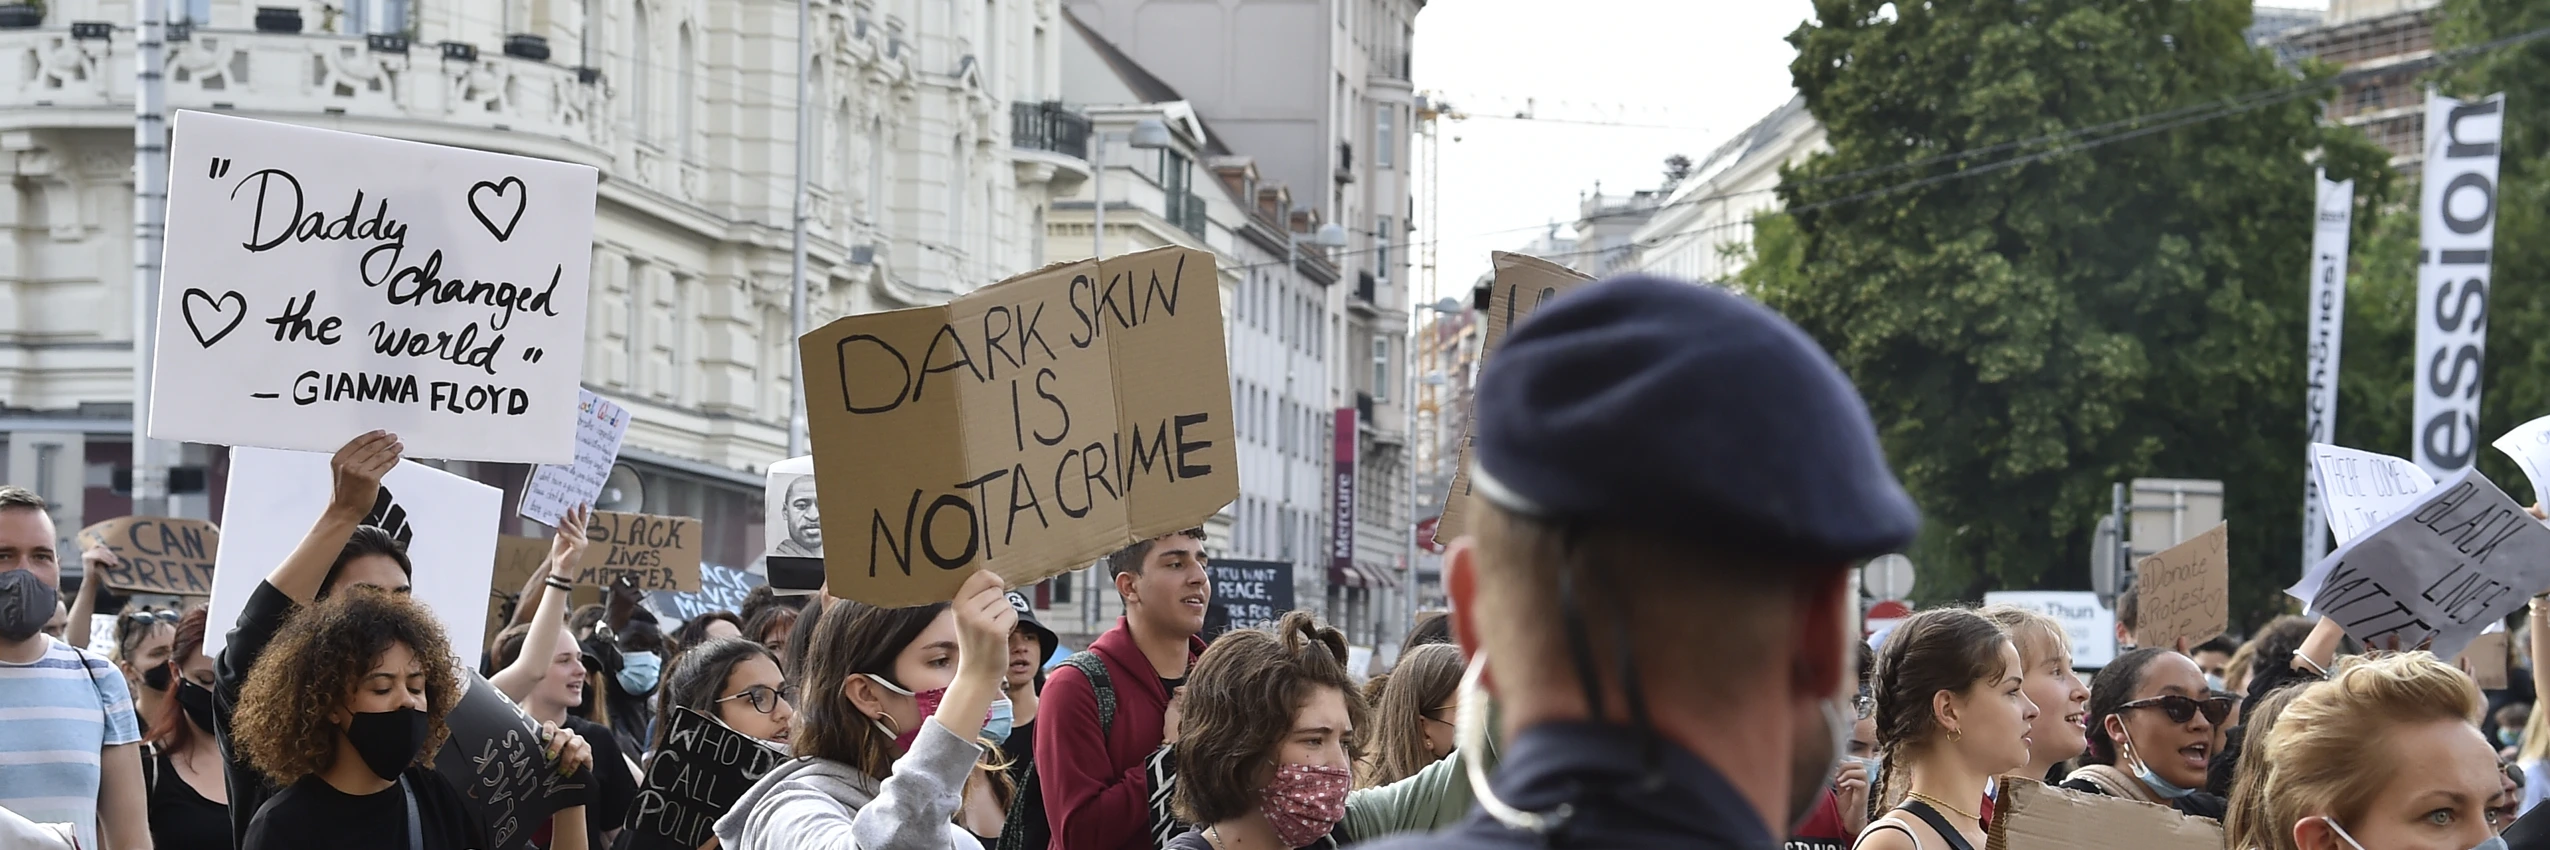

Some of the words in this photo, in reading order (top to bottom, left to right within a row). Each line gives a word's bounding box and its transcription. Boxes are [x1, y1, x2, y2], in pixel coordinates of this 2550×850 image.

[266, 290, 342, 345] the
[388, 249, 562, 331] changed
[2420, 100, 2499, 474] ession
[837, 301, 1058, 415] DARK
[1069, 253, 1185, 349] SKIN
[292, 371, 419, 406] GIANNA
[430, 381, 529, 415] FLOYD
[1011, 367, 1071, 451] IS
[1055, 412, 1213, 519] CRIME
[2320, 455, 2367, 498] THERE
[2369, 458, 2419, 497] COMES
[585, 512, 686, 549] BLACK
[1335, 473, 1351, 558] Mercure
[2414, 480, 2527, 564] BLACK
[1216, 567, 1240, 580] YOU
[1241, 568, 1277, 581] WANT
[2421, 563, 2511, 625] LIVES
[1248, 604, 1274, 619] FOR
[502, 729, 539, 802] LIVES
[669, 711, 741, 766] WHO
[472, 738, 518, 849] BLACK
[648, 750, 721, 809] CALL
